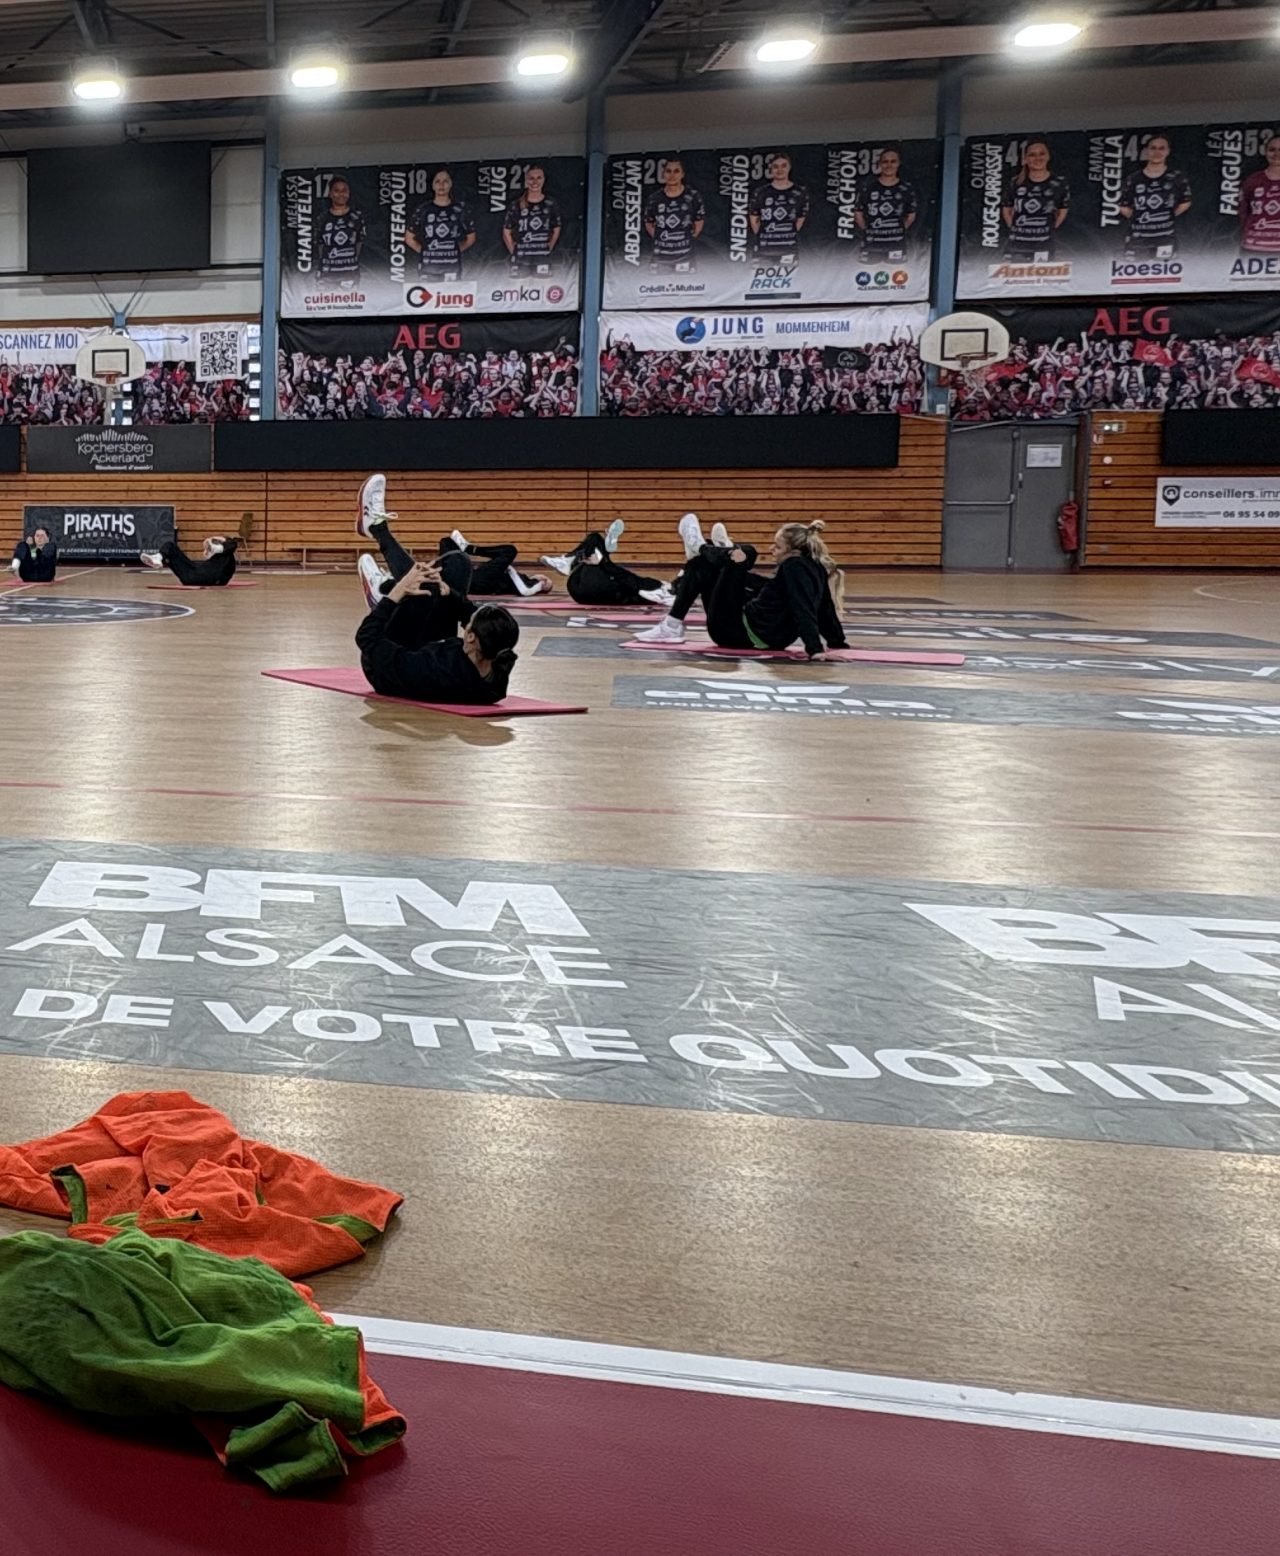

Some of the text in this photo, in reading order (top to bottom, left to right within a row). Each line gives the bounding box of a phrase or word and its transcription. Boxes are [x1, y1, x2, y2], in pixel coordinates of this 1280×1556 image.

[858, 149, 883, 175] 35
[971, 142, 985, 188] OLIVIA
[1088, 136, 1104, 182] EMMA
[1219, 130, 1243, 215] FARGUES
[314, 174, 334, 199] 17
[408, 170, 427, 194] 18
[478, 166, 491, 195] LISA
[490, 166, 507, 212] VLUG
[612, 161, 625, 210] DALILA
[720, 155, 732, 196] NORA
[826, 150, 840, 204] ALBANE
[1101, 135, 1124, 227] TUCCELLA
[730, 154, 750, 262] SNEDKERUD
[837, 150, 857, 239] FRACHON
[297, 176, 312, 273] CHANTELLY
[390, 171, 407, 282] MOSTEFAOUI
[624, 160, 642, 266] ABDESSELAM
[754, 266, 797, 278] POLY
[991, 263, 1071, 278] Antoni
[1112, 260, 1183, 276] koesio
[1230, 257, 1280, 275] ADE
[491, 286, 540, 302] emka
[639, 284, 705, 294] Crédit Mutuel
[750, 277, 793, 290] RACK
[304, 292, 366, 304] cuisinella
[434, 292, 474, 308] jung
[711, 317, 851, 336] JUNG MOMMENHEIM
[1087, 306, 1170, 336] AEG
[54, 333, 79, 349] MOI
[393, 323, 462, 350] AEG
[78, 442, 154, 457] Kochersberg
[89, 453, 146, 465] Ackerland
[63, 513, 135, 536] PIRATHS
[644, 689, 937, 710] erima
[27, 860, 592, 938] BFM
[5, 917, 629, 990] ALSACE
[901, 902, 1280, 978] BF
[13, 986, 176, 1028] DE
[201, 1001, 647, 1062] VOTRE
[668, 1033, 1280, 1108] QUOTIDI
